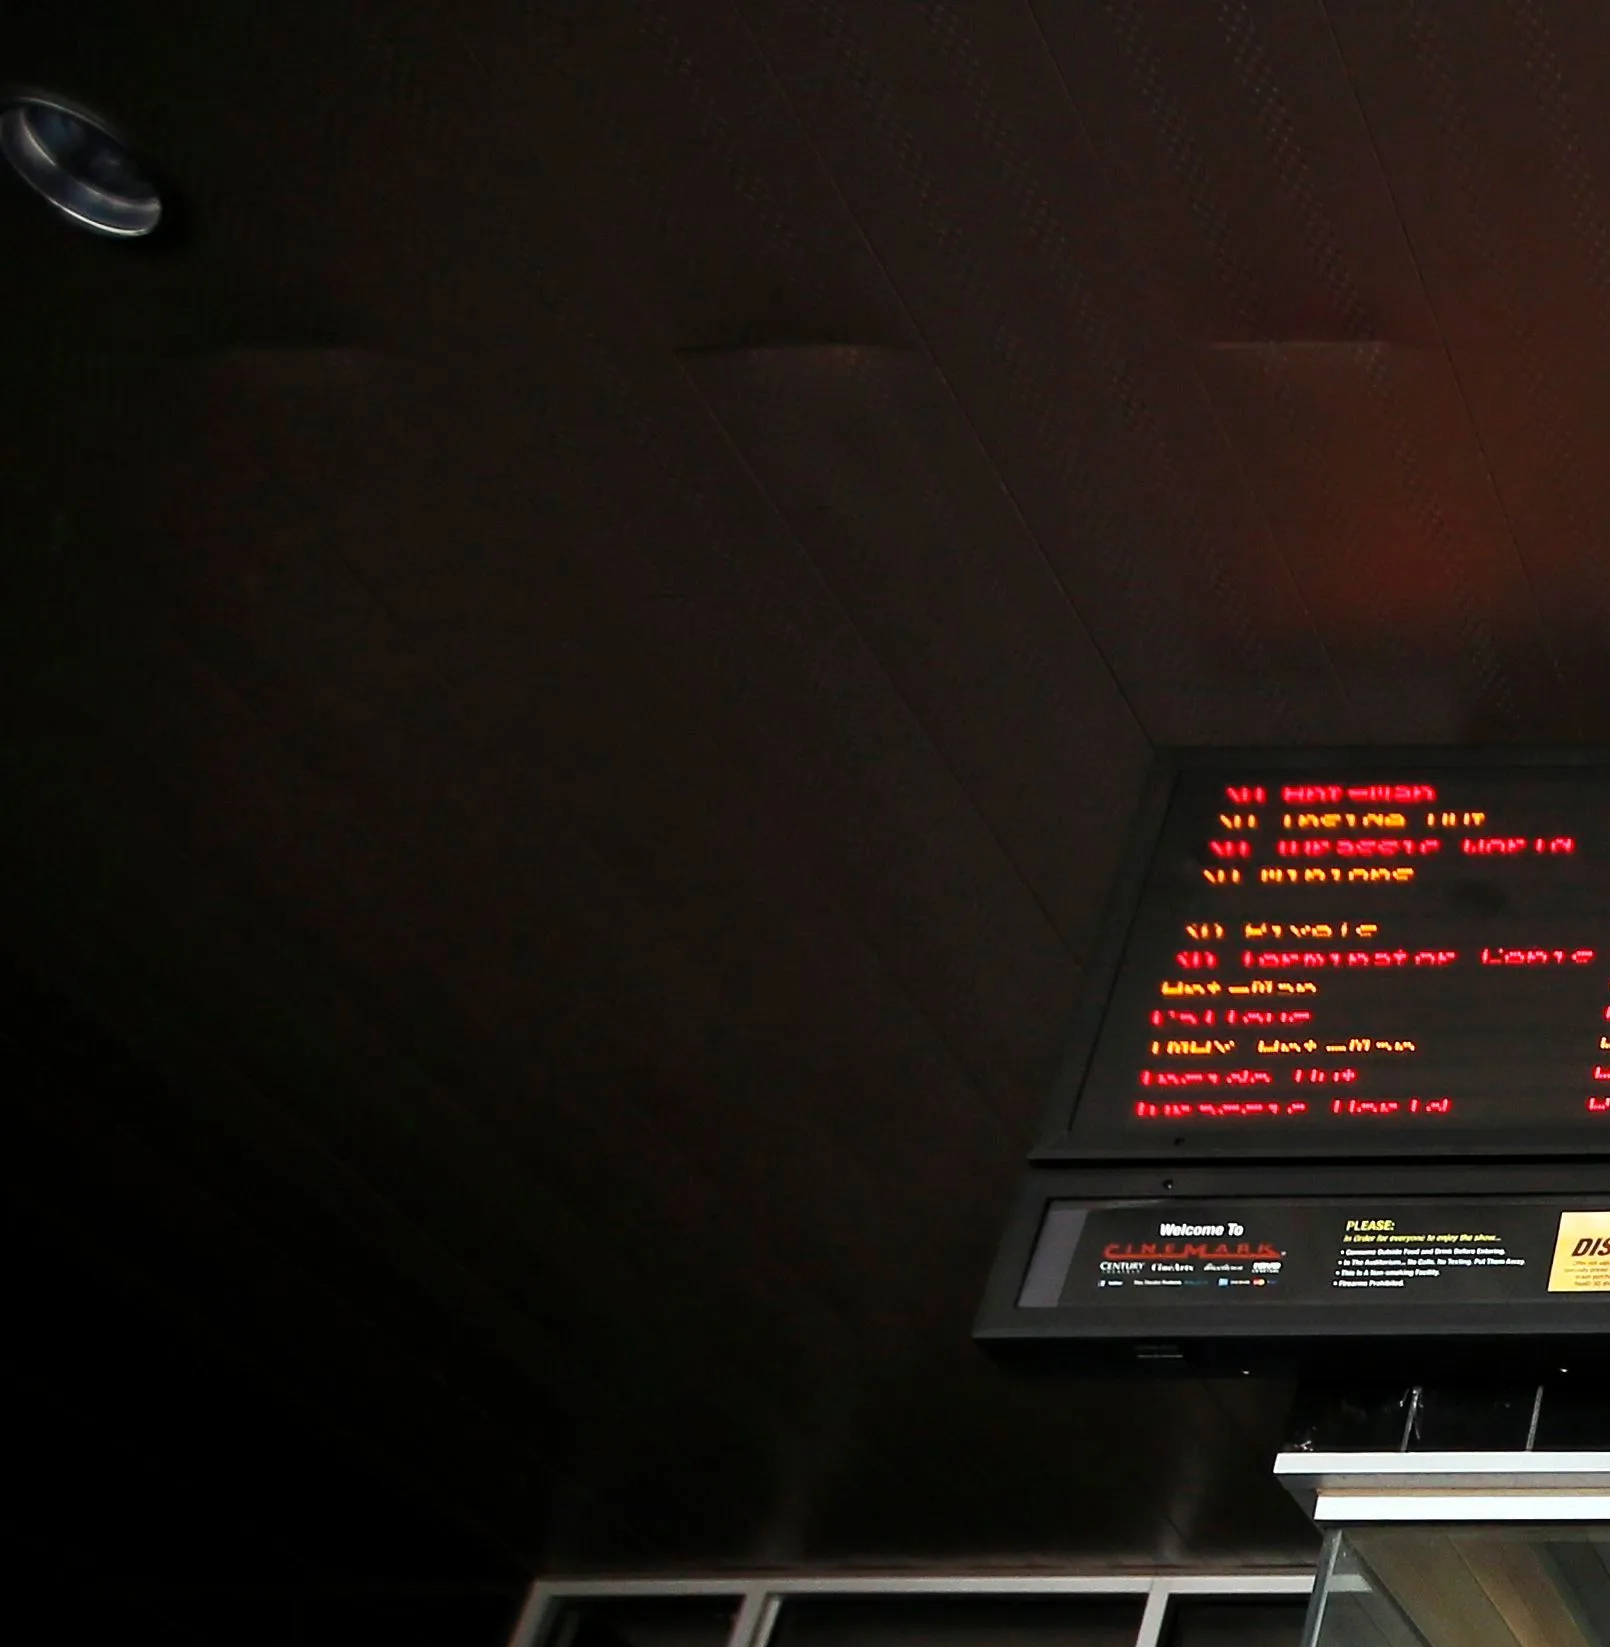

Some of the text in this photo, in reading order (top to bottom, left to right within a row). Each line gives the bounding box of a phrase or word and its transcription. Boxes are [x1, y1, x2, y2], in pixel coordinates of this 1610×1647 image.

[1159, 1222, 1244, 1237] Welcome To
[1346, 1220, 1396, 1231] PLEASE:
[1437, 1235, 1458, 1243] enjoy
[1103, 1242, 1281, 1259] CINEMARK
[1100, 1262, 1145, 1271] CENTURY
